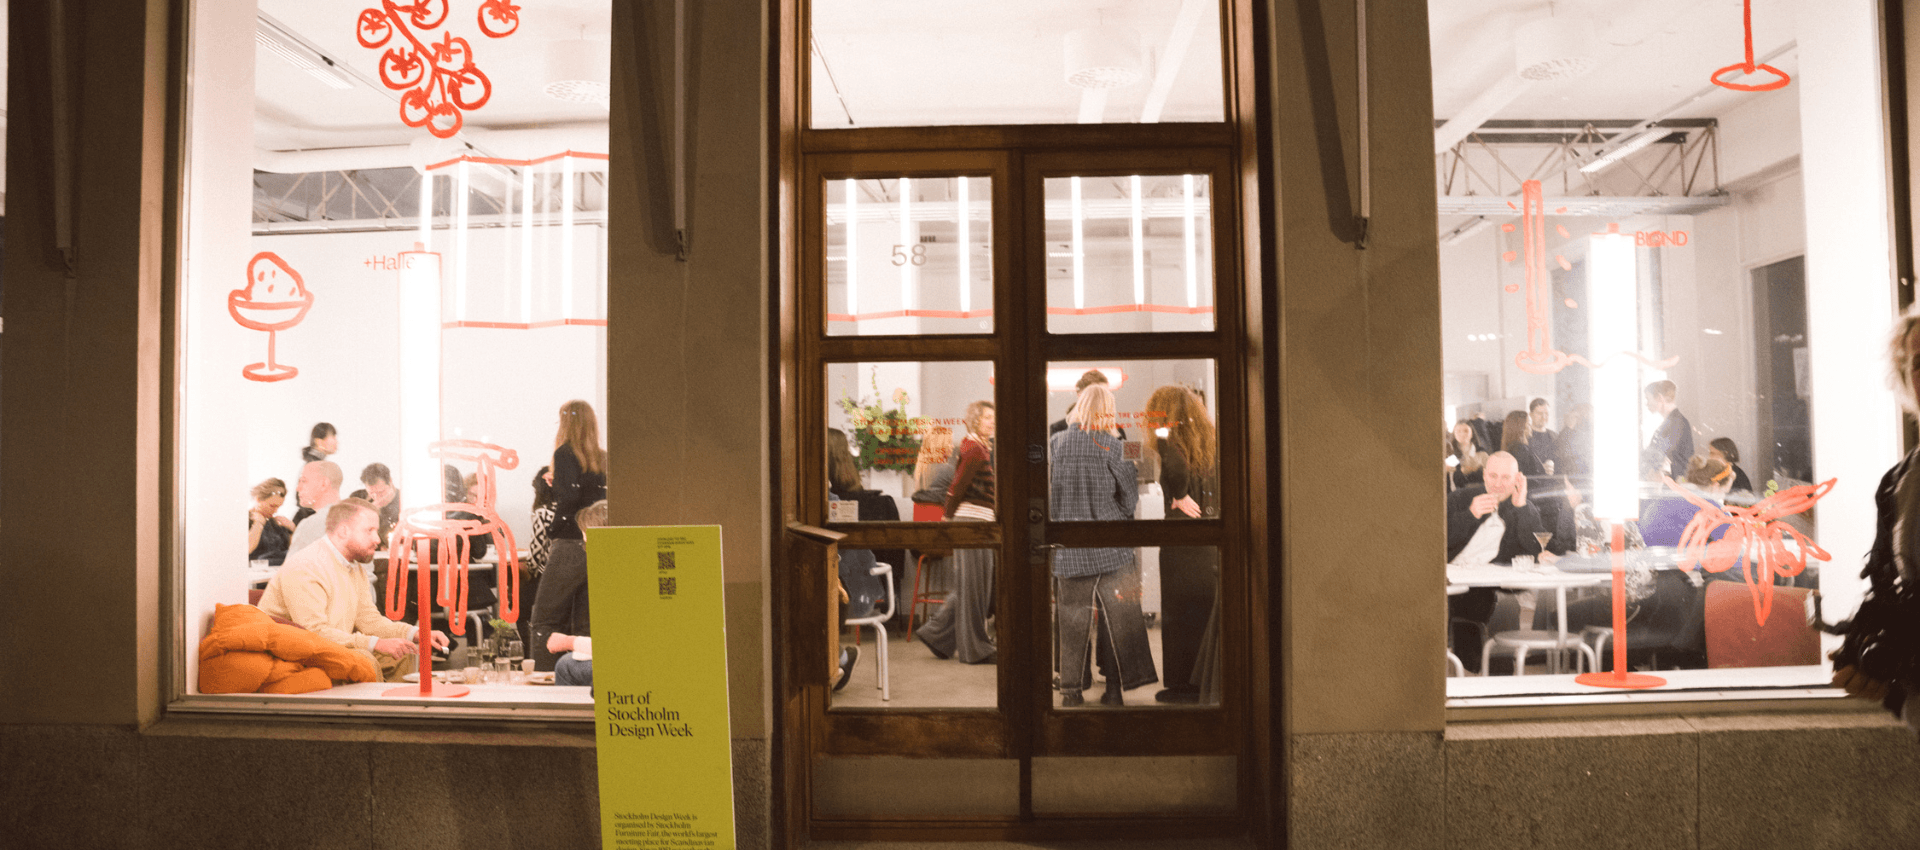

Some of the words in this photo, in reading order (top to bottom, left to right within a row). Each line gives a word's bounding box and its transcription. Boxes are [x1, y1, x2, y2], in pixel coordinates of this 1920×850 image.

[891, 244, 927, 267] 58
[943, 417, 967, 426] WEEK
[607, 691, 634, 705] Part
[637, 691, 653, 705] of
[607, 707, 680, 721] Stockholm
[609, 723, 655, 740] Design
[656, 723, 694, 737] Week
[614, 812, 649, 820] Stockholm
[650, 813, 673, 822] Design
[673, 812, 691, 820] Week
[614, 821, 646, 829] organised
[646, 821, 655, 829] by
[655, 821, 691, 829] Stockholm
[615, 829, 646, 837] Furniture
[696, 830, 718, 839] largest
[615, 839, 643, 847] meeting
[643, 838, 660, 847] place
[670, 838, 715, 846] Scandinavian
